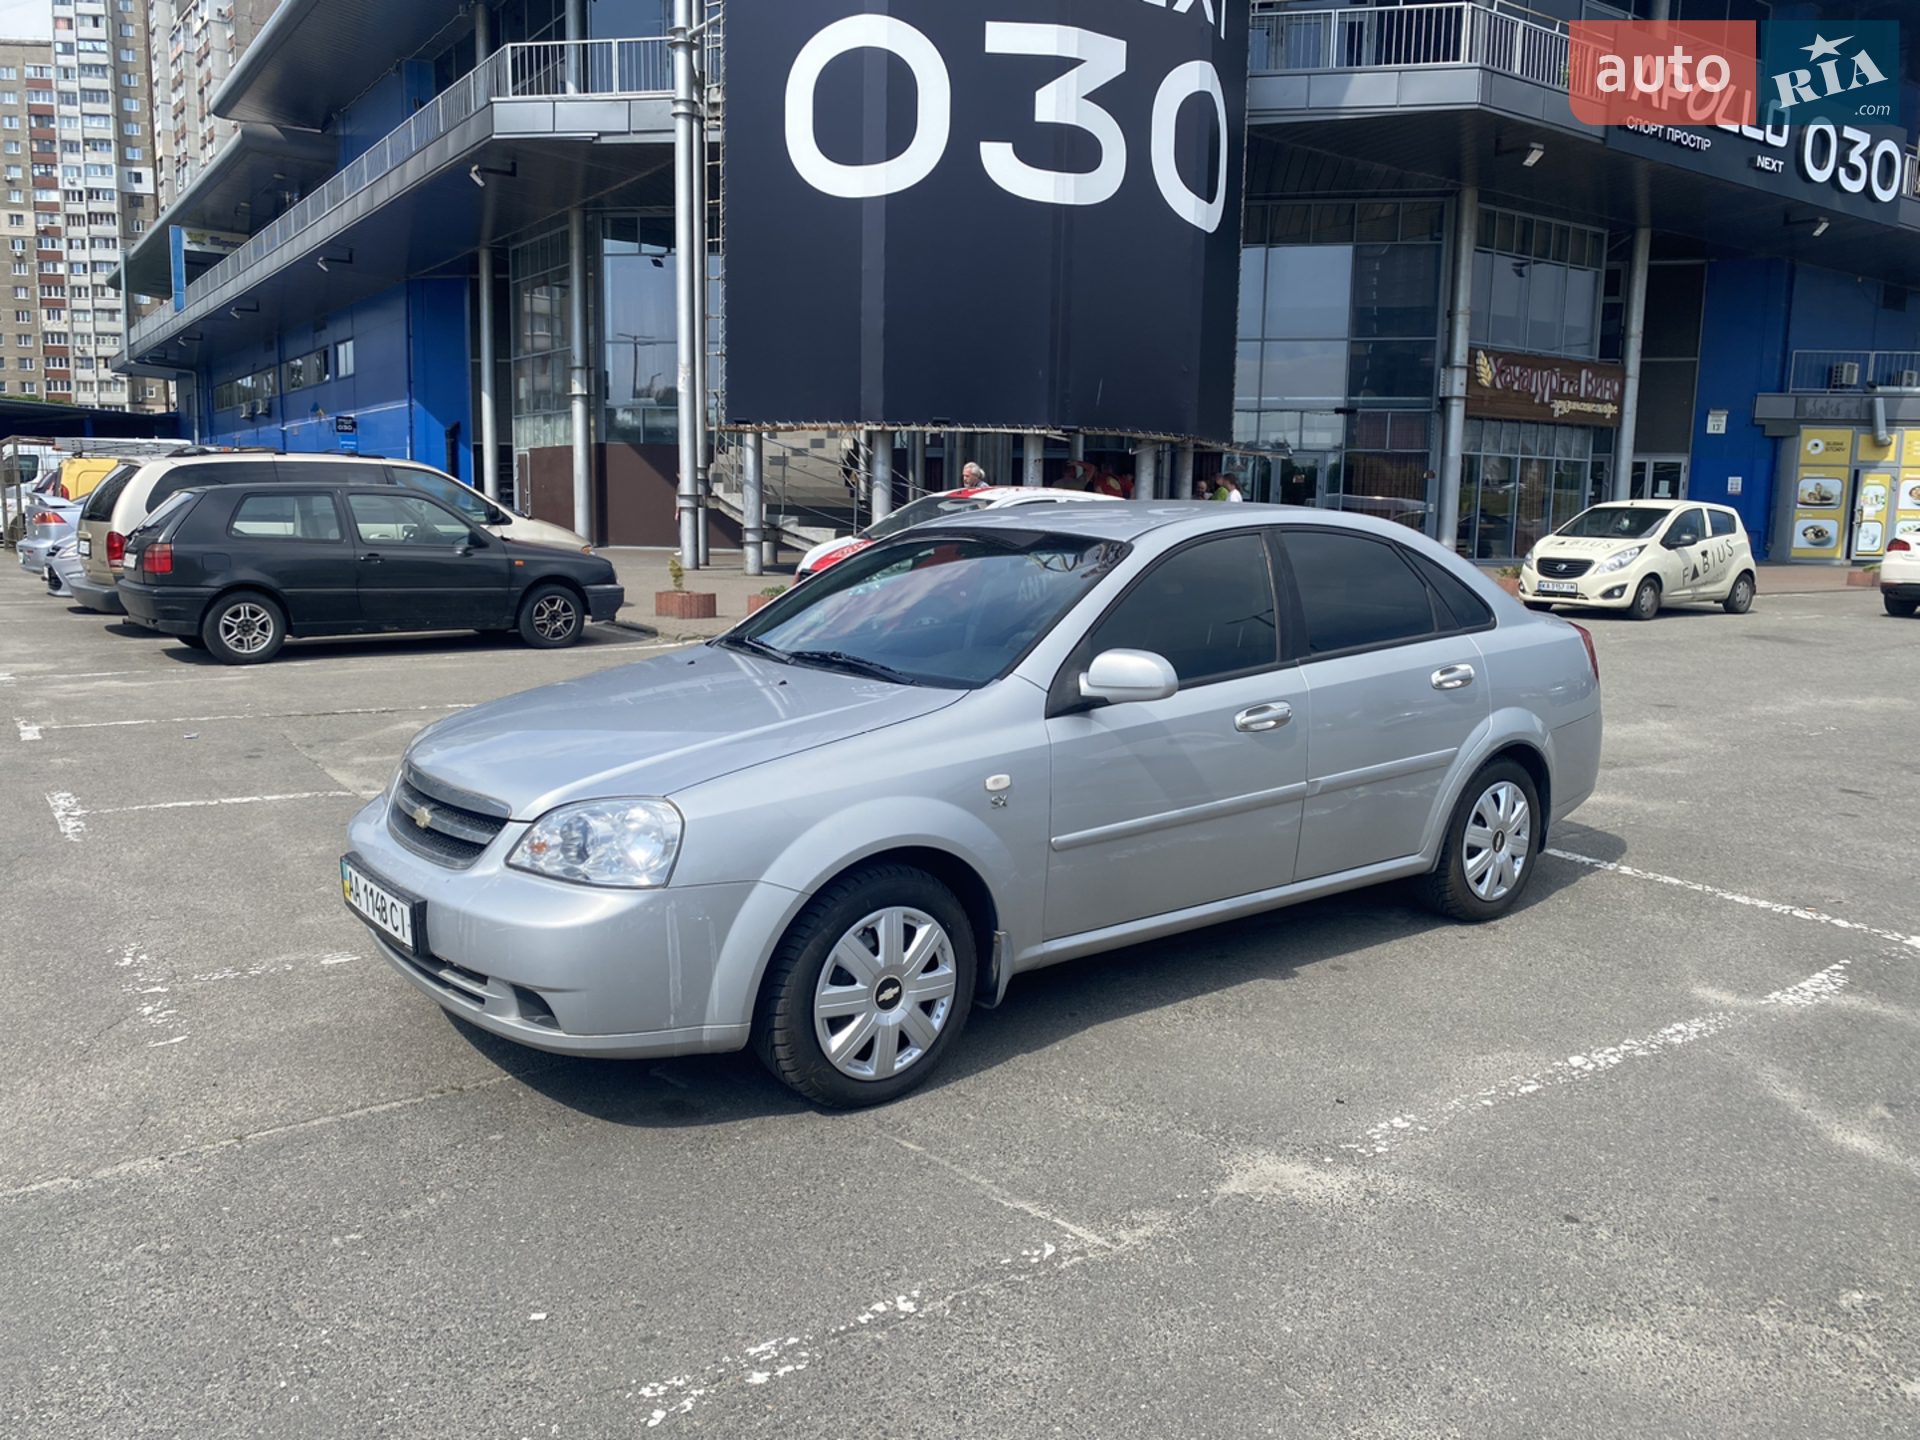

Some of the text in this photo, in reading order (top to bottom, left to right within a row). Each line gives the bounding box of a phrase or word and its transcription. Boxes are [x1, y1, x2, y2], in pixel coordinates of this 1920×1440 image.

[785, 12, 1228, 234] 030
[1626, 115, 1712, 152] СПОРТ ПРОСТІР
[1756, 154, 1785, 174] NEXT
[1803, 116, 1901, 203] 030
[1580, 368, 1621, 400] Вино
[363, 883, 388, 926] 1148
